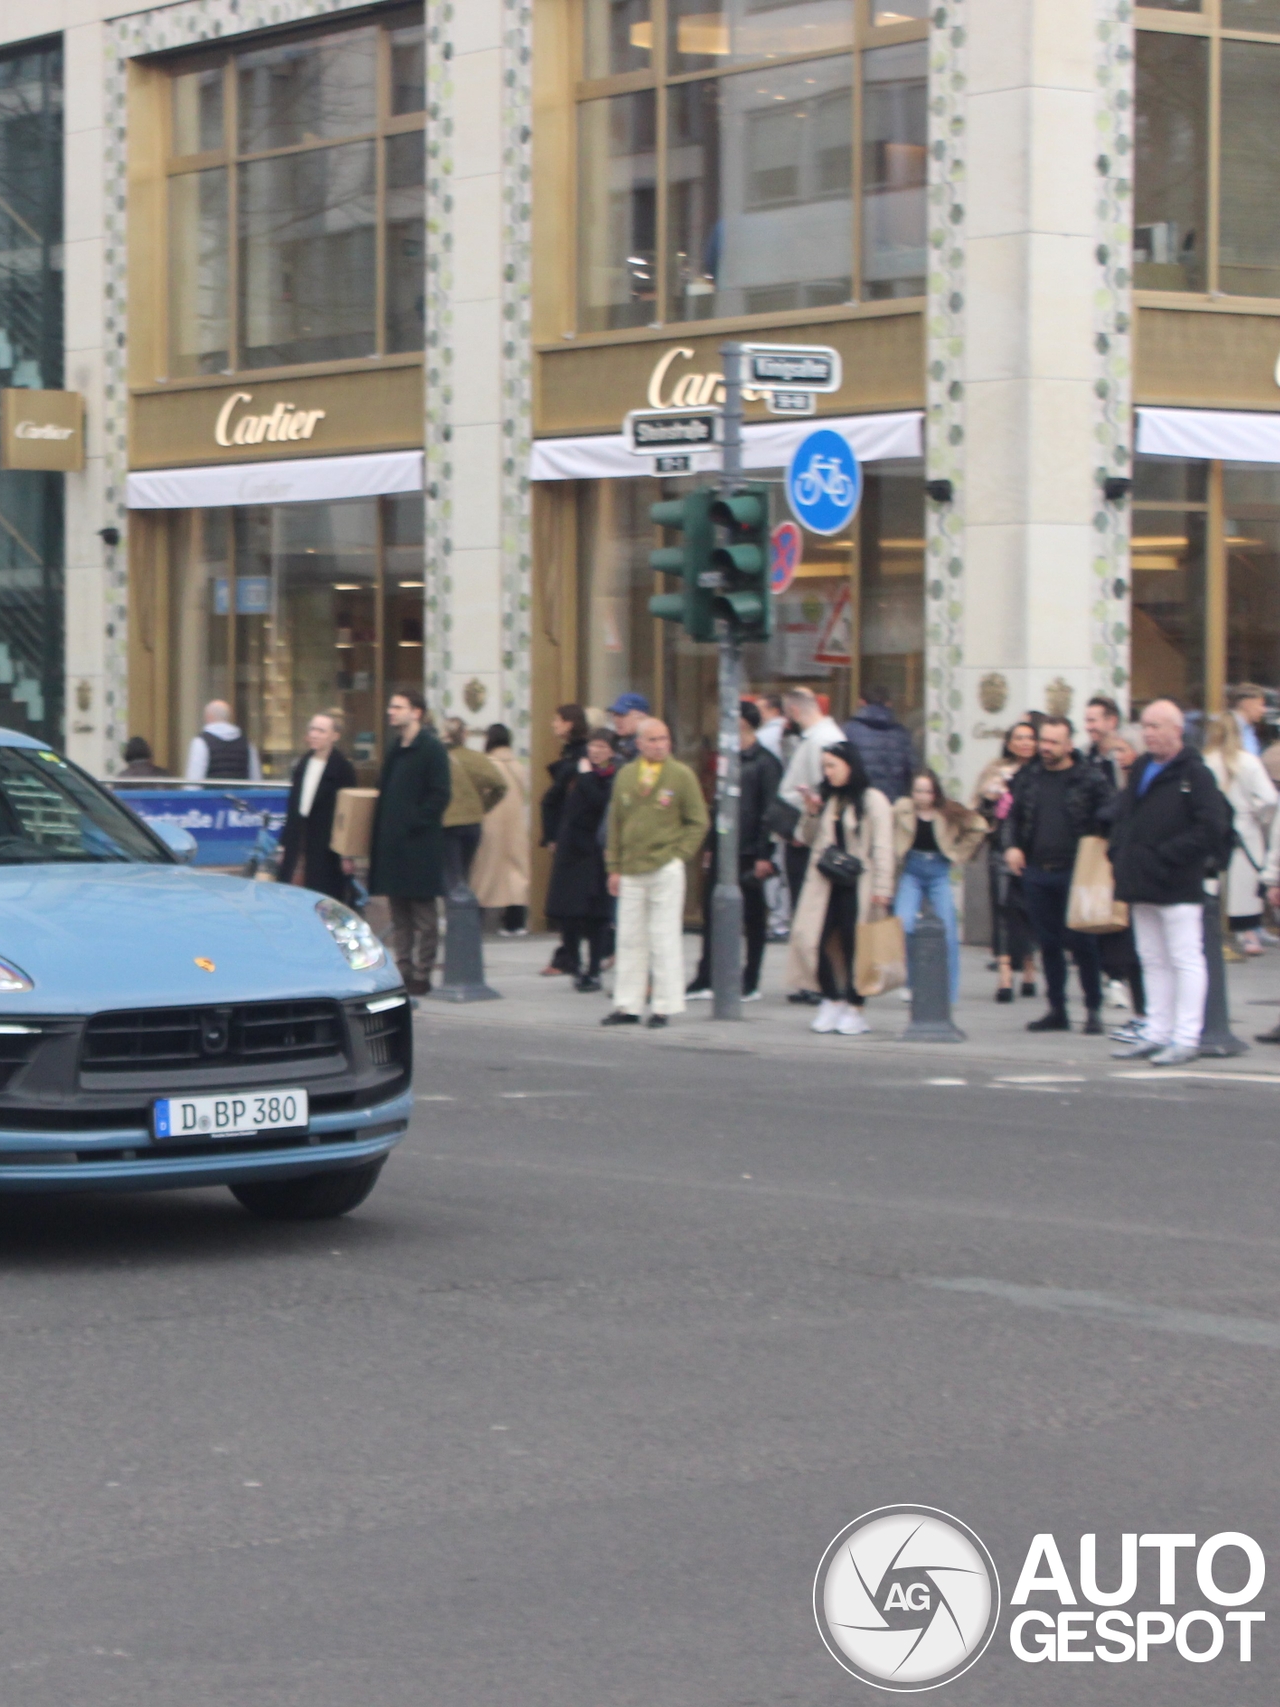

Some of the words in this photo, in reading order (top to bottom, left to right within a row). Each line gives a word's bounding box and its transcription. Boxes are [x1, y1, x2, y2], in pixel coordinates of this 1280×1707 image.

[215, 391, 326, 447] Cartier
[182, 1103, 197, 1130] D
[215, 1100, 246, 1127] BP
[253, 1096, 297, 1124] 380
